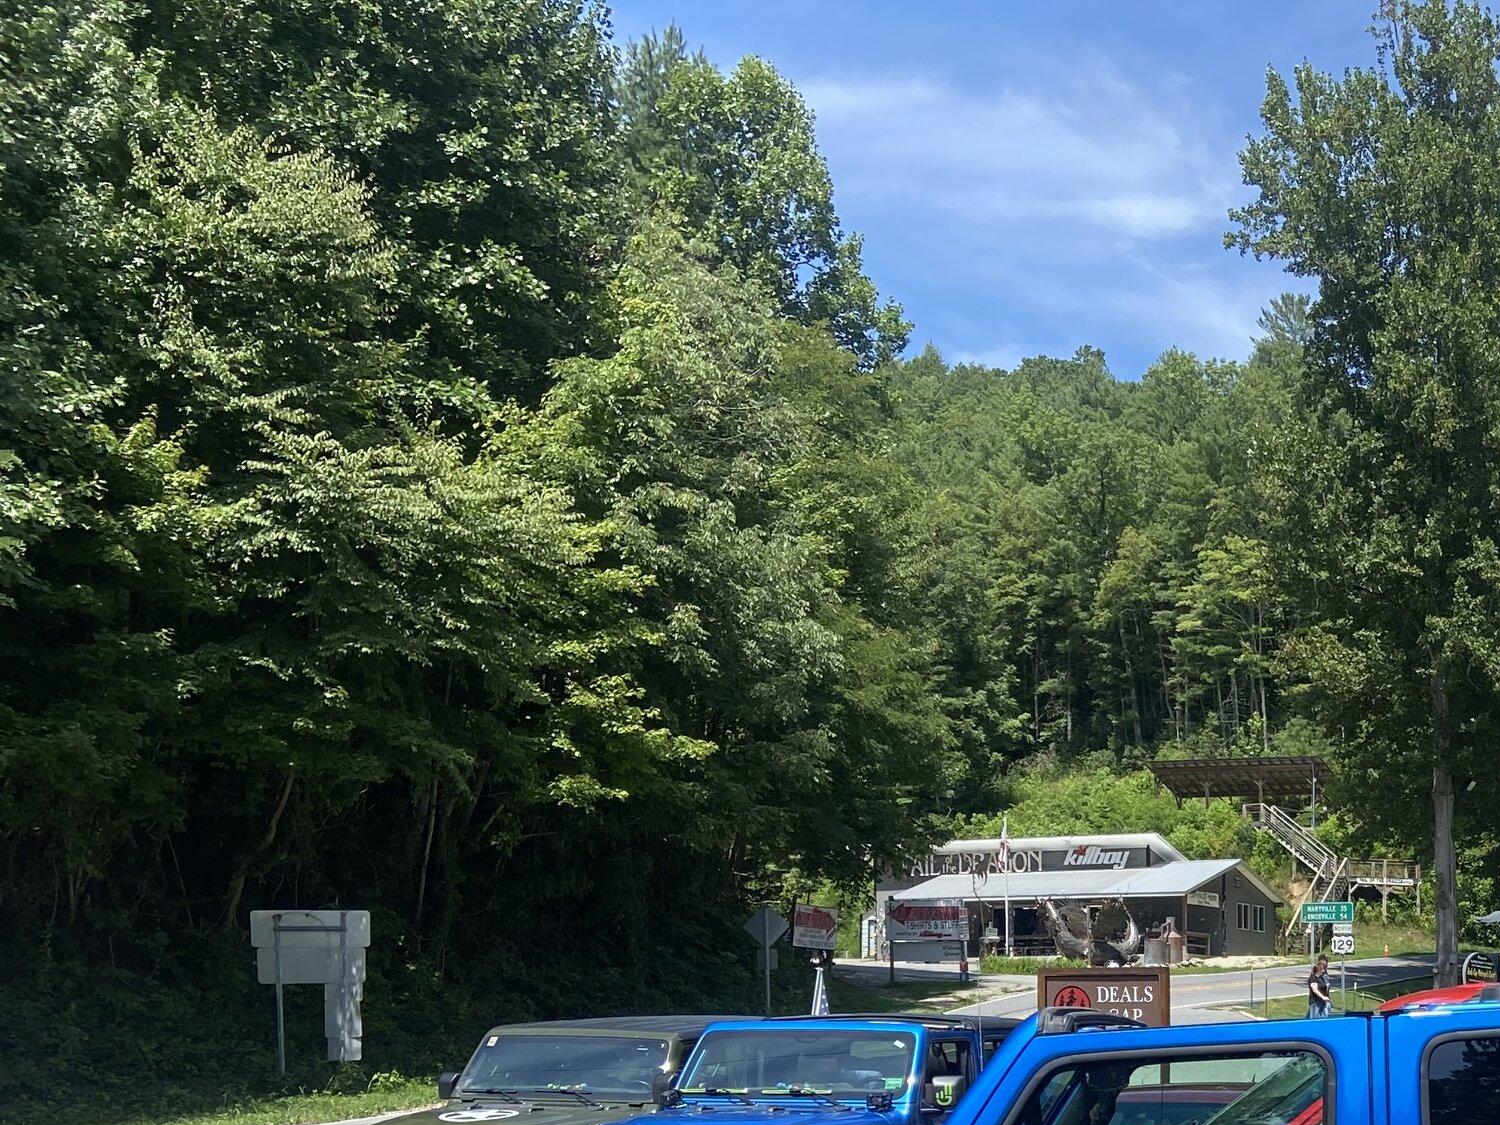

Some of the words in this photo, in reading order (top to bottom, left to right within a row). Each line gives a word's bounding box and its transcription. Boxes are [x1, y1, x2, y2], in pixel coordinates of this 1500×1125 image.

[904, 853, 941, 877] AIL
[1332, 939, 1353, 950] 129
[1096, 985, 1154, 1003] DEALS
